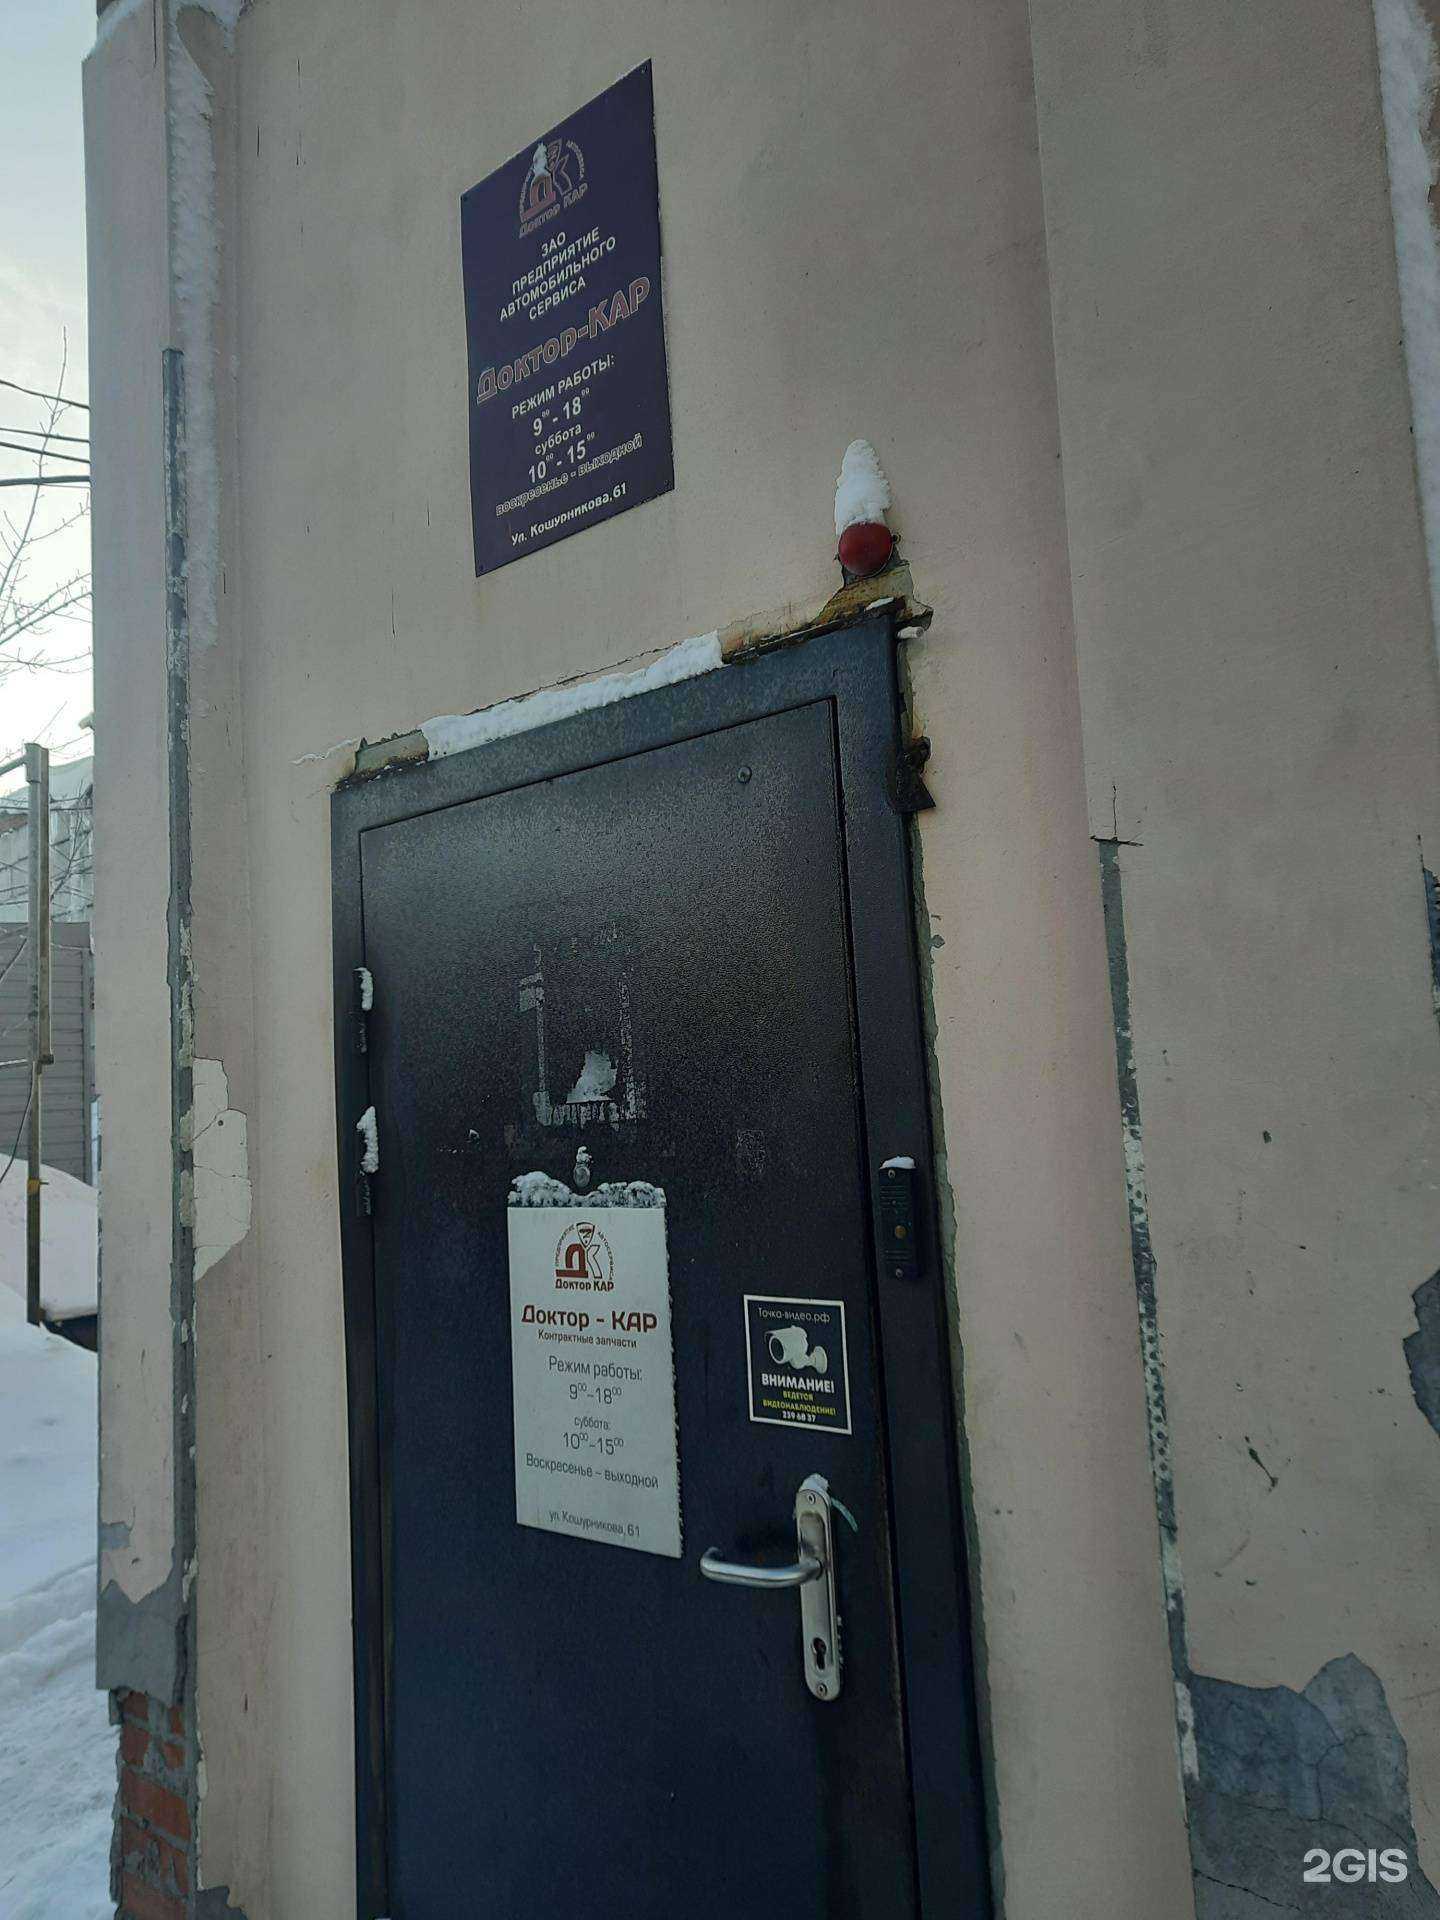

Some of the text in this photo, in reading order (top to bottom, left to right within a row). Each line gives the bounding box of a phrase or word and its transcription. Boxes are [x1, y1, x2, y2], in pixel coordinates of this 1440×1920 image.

[512, 226, 600, 295] ПРЕДПРИЯТИЕ
[541, 231, 566, 258] ЗАО
[499, 236, 616, 322] АВТОМОБИЛЬНОГО
[529, 276, 586, 320] СЕРВИСА
[512, 353, 615, 419] РЕЖИМ РАБОТЫ:
[534, 424, 582, 456] суббота
[577, 432, 643, 477] выходной
[611, 1311, 658, 1333] КАР
[538, 1329, 637, 1348] Контрактные запчасти
[549, 1355, 643, 1381] Режим работы:
[761, 1373, 835, 1394] ВНИМАНИЕ!
[526, 1453, 593, 1478] Воскресенье
[604, 1469, 659, 1489] выходной
[627, 1523, 640, 1536] 61
